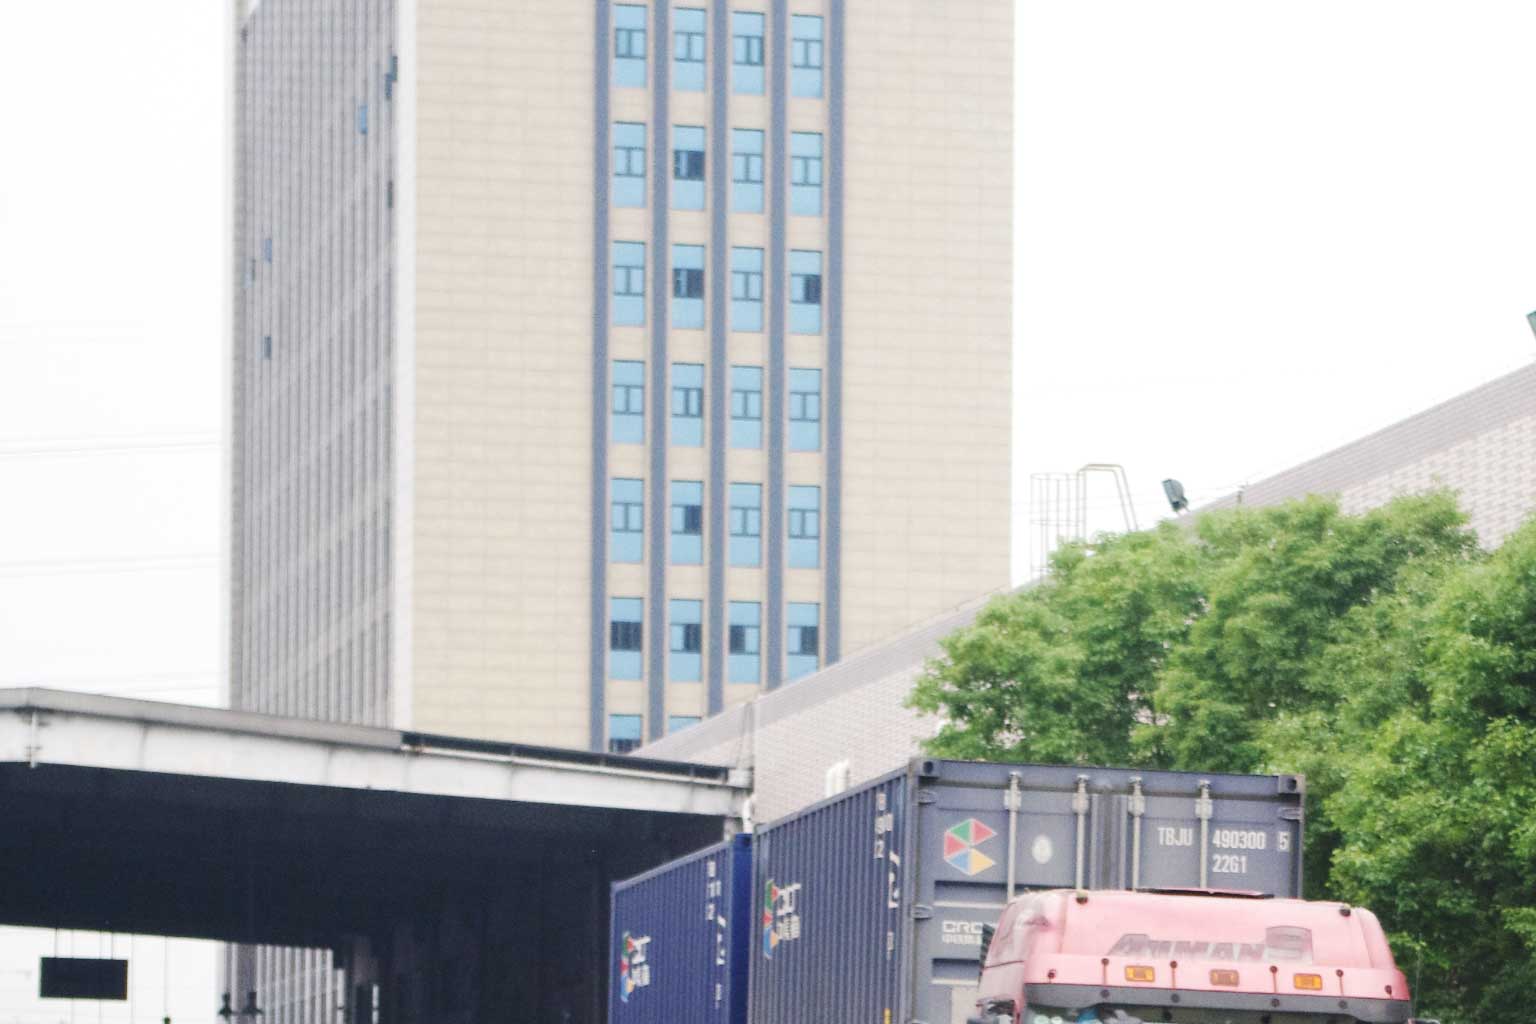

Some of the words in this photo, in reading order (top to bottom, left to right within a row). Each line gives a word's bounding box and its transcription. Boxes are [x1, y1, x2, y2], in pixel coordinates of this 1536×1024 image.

[1157, 827, 1193, 846] TBJU
[1212, 830, 1267, 850] 490300
[1279, 831, 1290, 851] 5
[1212, 854, 1248, 873] 22G1
[942, 920, 998, 934] CRC
